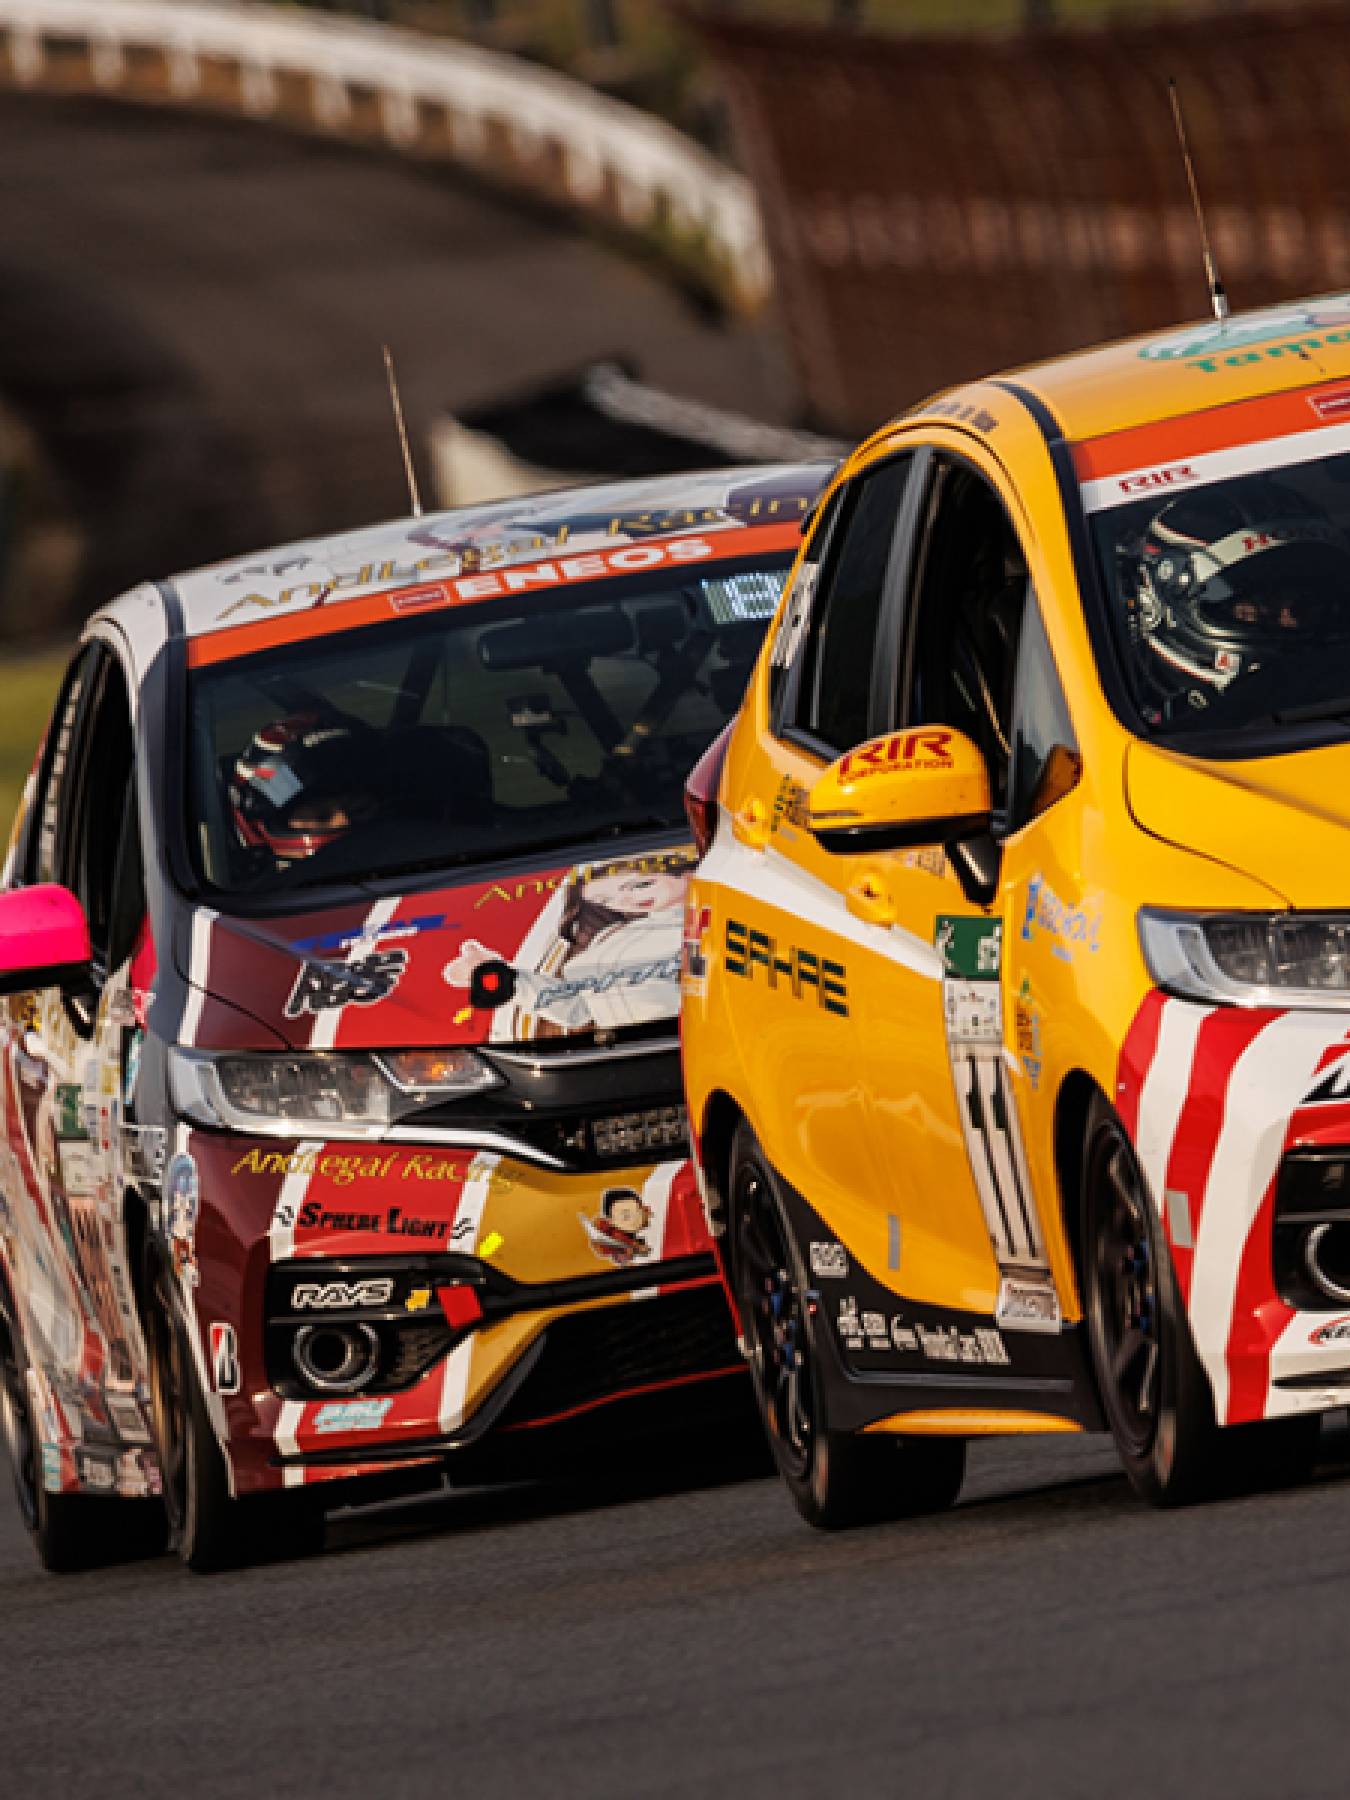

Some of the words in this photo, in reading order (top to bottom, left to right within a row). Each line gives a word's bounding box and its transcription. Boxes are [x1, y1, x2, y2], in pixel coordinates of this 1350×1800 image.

[1119, 464, 1200, 495] RIR
[610, 496, 809, 536] Racin
[457, 536, 714, 600] ENEOS
[837, 732, 954, 777] RIR
[473, 846, 694, 909] AndLega
[291, 1278, 395, 1309] RAYS
